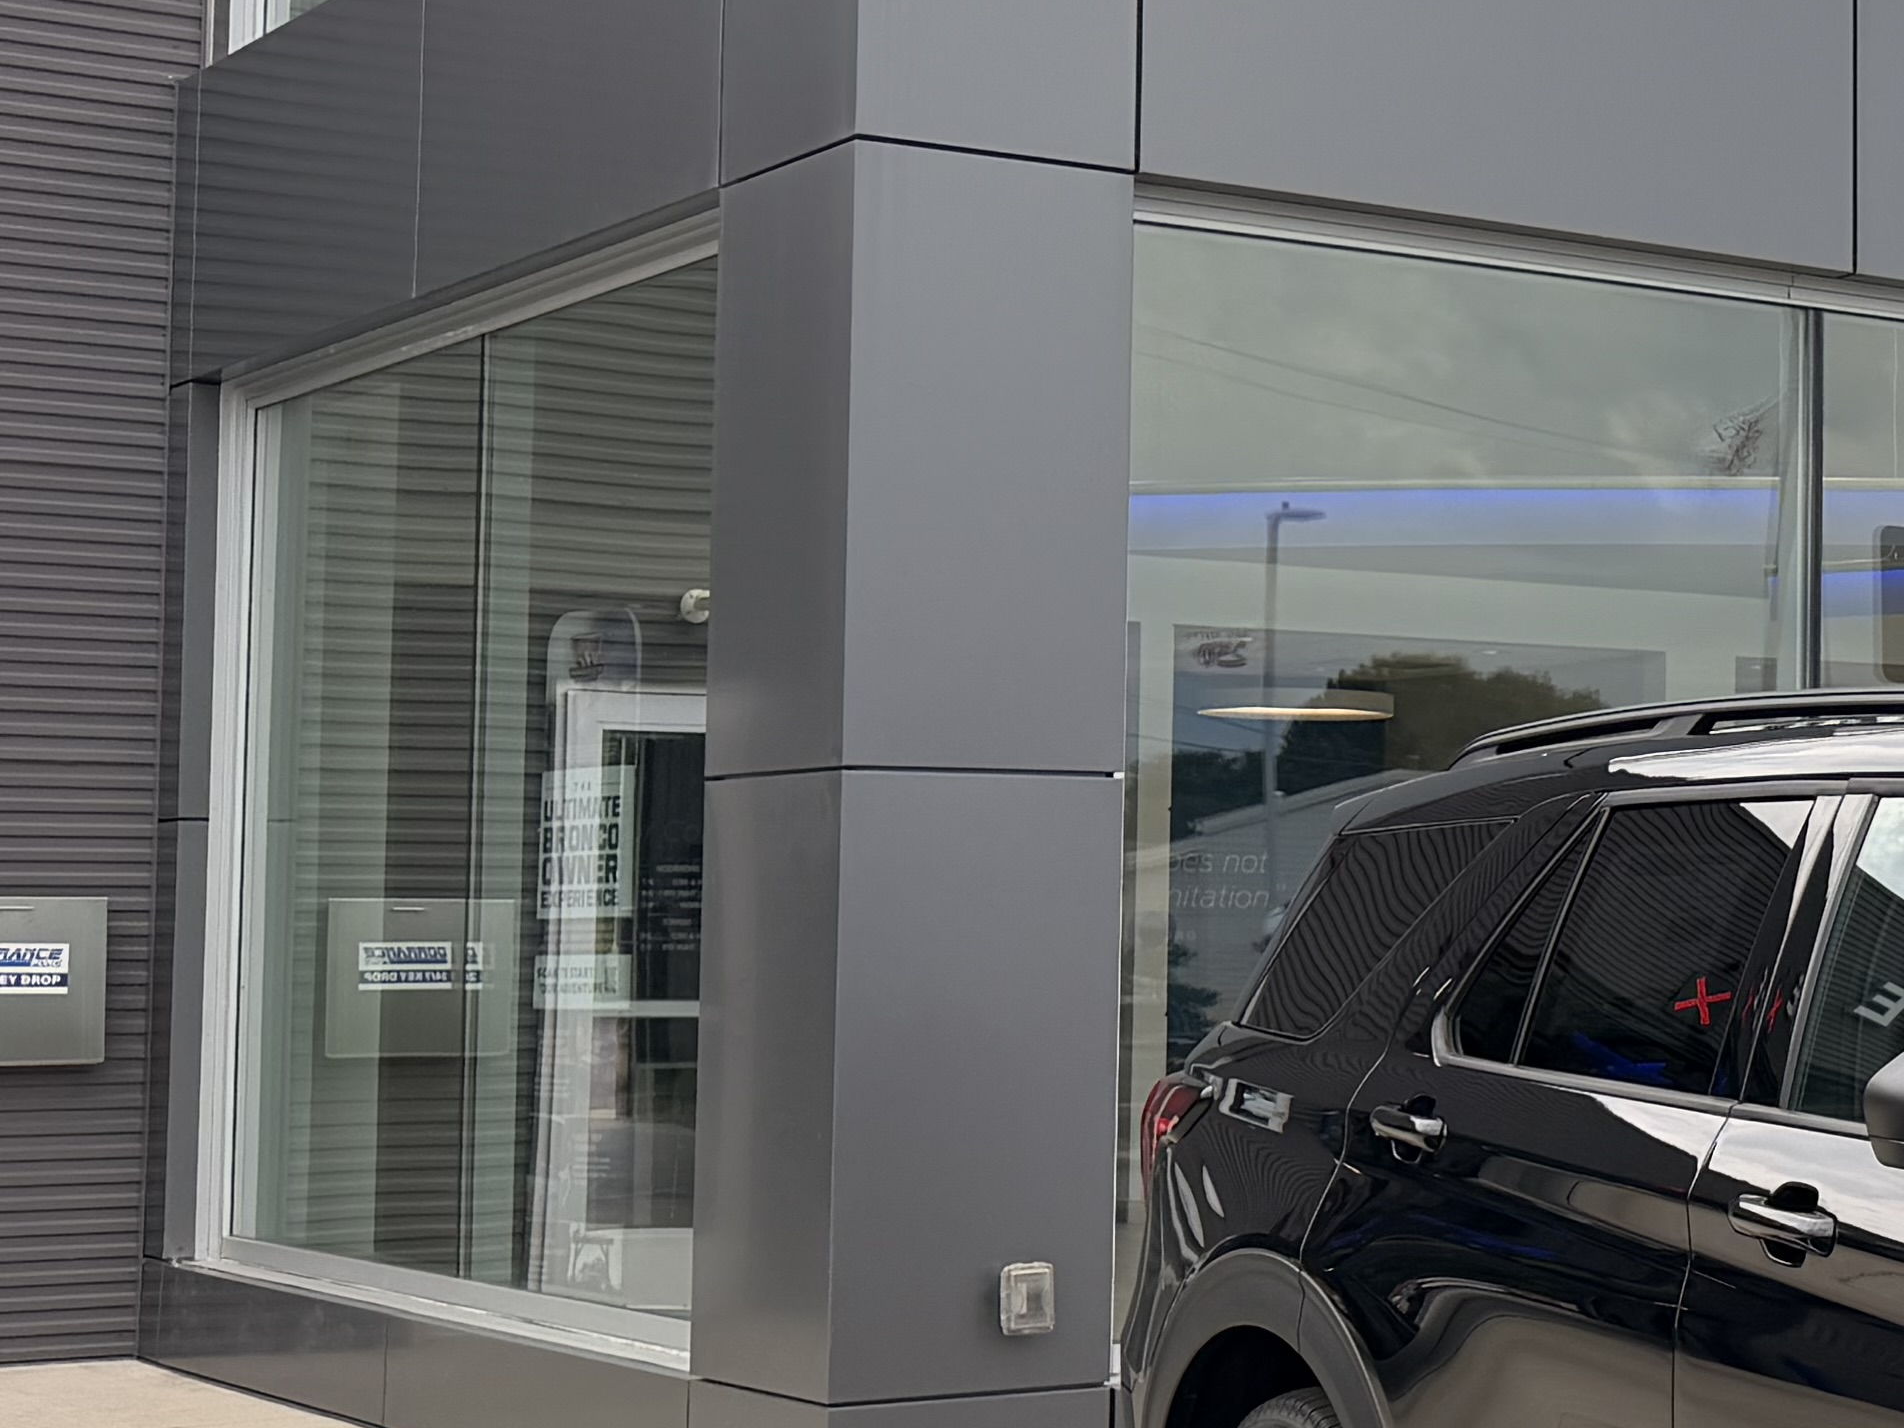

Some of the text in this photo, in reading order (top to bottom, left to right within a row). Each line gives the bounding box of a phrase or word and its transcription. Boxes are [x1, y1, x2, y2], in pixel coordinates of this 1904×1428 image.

[544, 795, 620, 822] ULTIMATE
[543, 823, 619, 853] BRONCO
[542, 853, 618, 886] OWNER
[1223, 851, 1269, 874] not
[541, 888, 618, 909] EXPERIENCE
[21, 974, 61, 985] DROP
